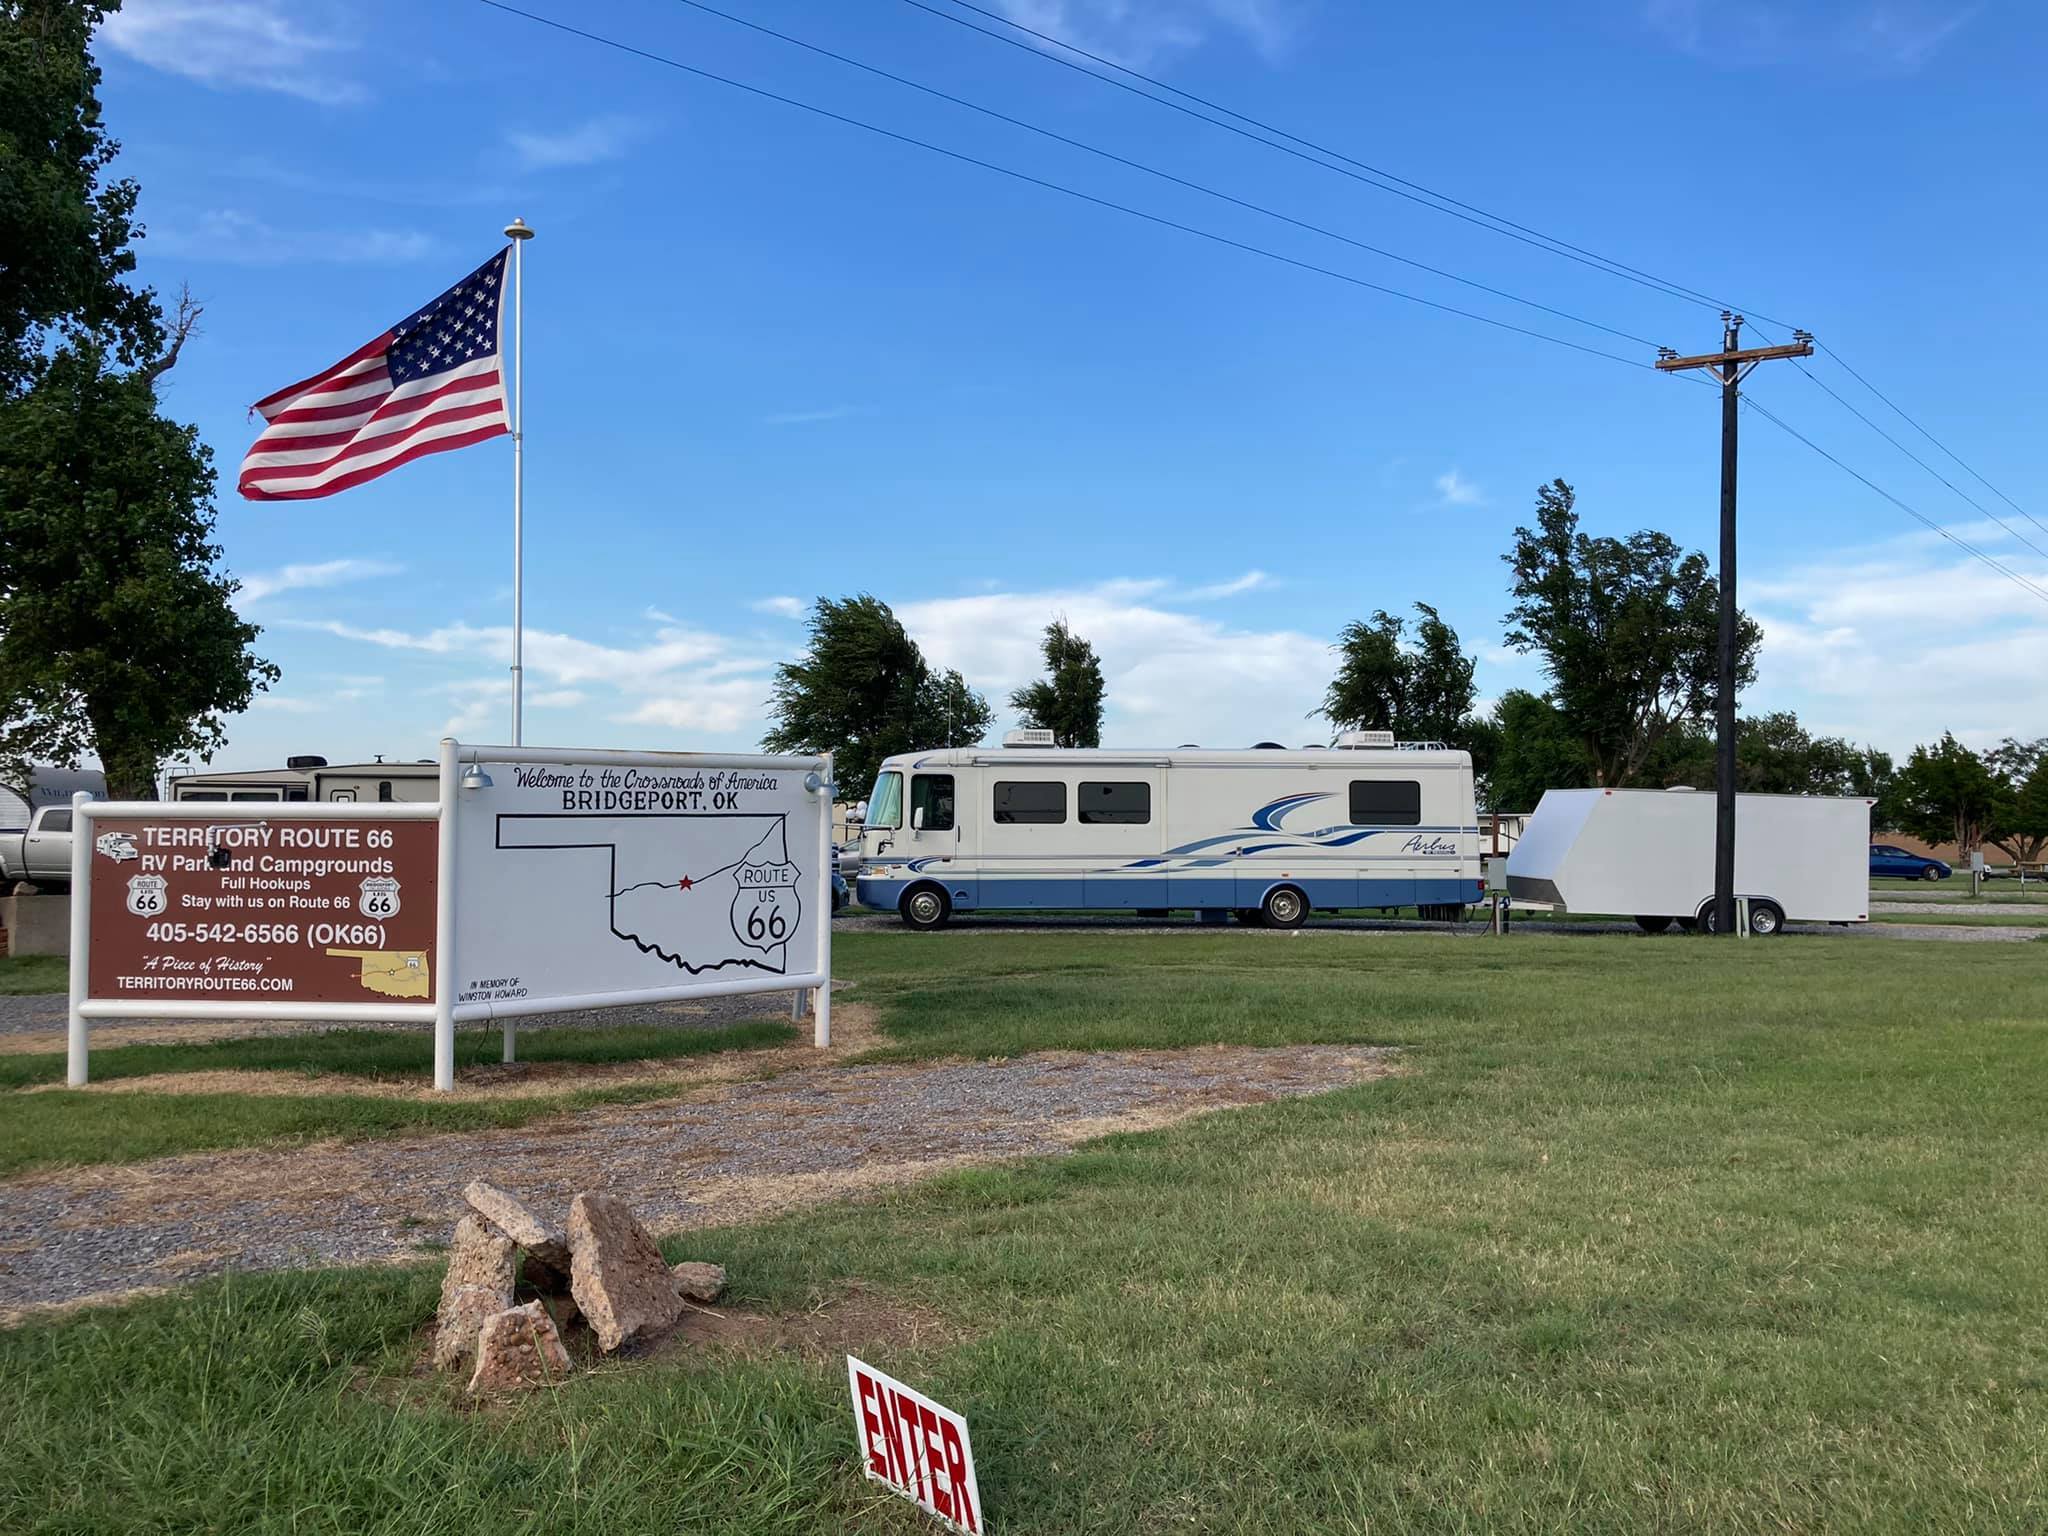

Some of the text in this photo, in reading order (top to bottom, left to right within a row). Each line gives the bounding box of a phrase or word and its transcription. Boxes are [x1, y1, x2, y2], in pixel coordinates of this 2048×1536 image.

[514, 767, 778, 791] Welcome to the Crossroads of America
[562, 790, 739, 811] BRIDGEPORT, OK
[143, 827, 394, 848] TERRITORY ROUTE 66
[142, 855, 394, 878] RV Park nd Campgrounds
[744, 868, 789, 883] ROUTE
[221, 877, 311, 892] Full Hookups
[136, 895, 158, 910] 66
[181, 894, 351, 910] Stay with us on Route 66
[758, 889, 776, 903] US
[369, 897, 391, 912] 66
[747, 904, 786, 940] 66
[146, 923, 386, 949] 405-542-6566 (OK66)
[162, 956, 196, 971] Piece
[199, 957, 213, 975] of
[117, 976, 293, 991] TERRITORYROUTE66.COM
[471, 977, 520, 989] IN MEMORY OF
[458, 988, 527, 1002] WINSTON HOWARD
[856, 1370, 977, 1534] ENTER
